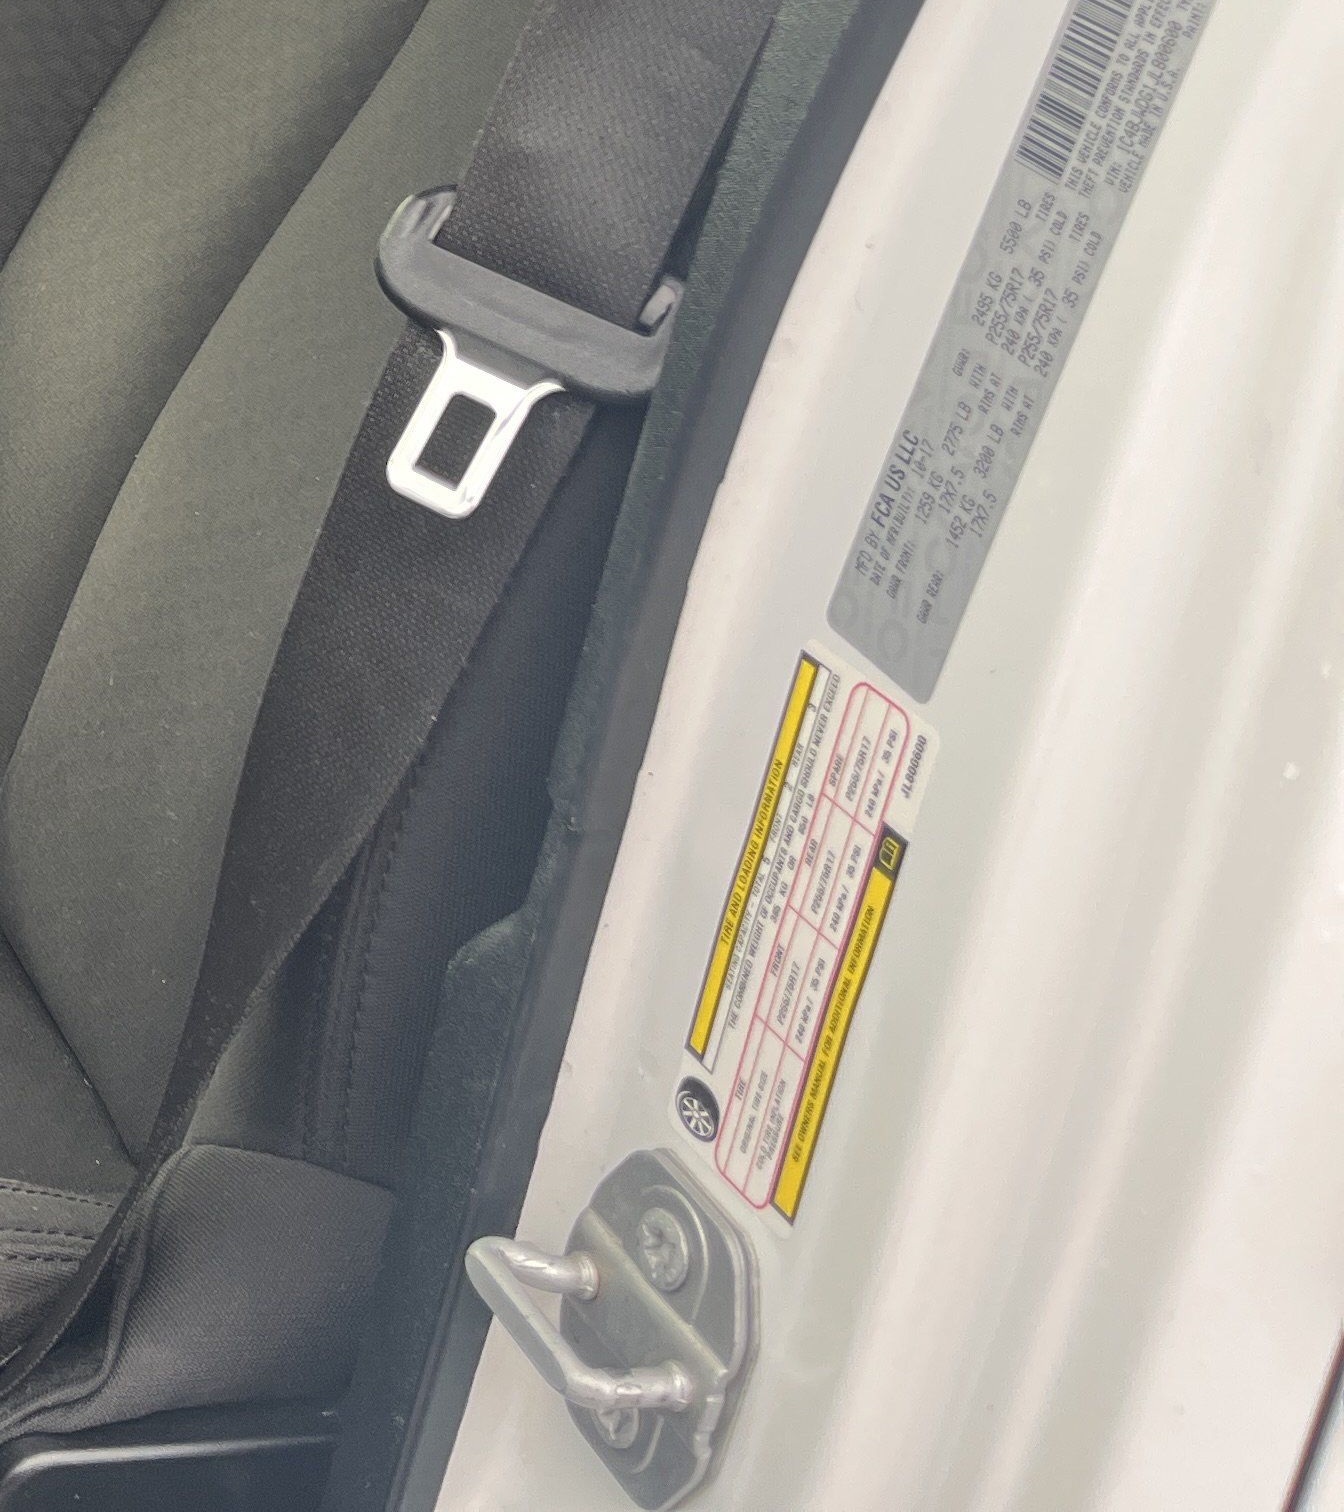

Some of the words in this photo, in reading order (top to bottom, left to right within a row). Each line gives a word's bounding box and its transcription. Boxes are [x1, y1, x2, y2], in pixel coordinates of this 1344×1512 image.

[1114, 50, 1131, 68] TO
[1121, 28, 1141, 52] ALL
[1093, 68, 1124, 120] CONFORMS
[1077, 166, 1100, 200] THEFT
[1090, 103, 1127, 168] PREVENTION
[1116, 46, 1151, 105] STANDARDS
[1141, 29, 1158, 45] IN
[1074, 119, 1103, 165] VEHICLE
[1116, 148, 1145, 195] VEHICLE
[1135, 120, 1157, 149] MADE
[1148, 101, 1164, 118] IN
[1063, 163, 1085, 193] THIS
[1102, 159, 1124, 188] VIN:
[970, 291, 995, 327] 2495
[984, 268, 1003, 292] KG
[998, 218, 1024, 255] 5500
[1013, 196, 1033, 218] LB
[912, 488, 936, 525] 1259
[925, 467, 945, 492] KG
[939, 419, 964, 457] 2775
[953, 398, 973, 422] LB
[967, 360, 987, 390] WITH
[983, 264, 1027, 346] P255/75R17
[1034, 190, 1056, 223] TIRES
[936, 463, 966, 515] 17X7.5
[976, 386, 996, 415] RIMS
[987, 370, 1003, 388] AT
[999, 326, 1021, 356] 240
[1012, 303, 1030, 326] KPA
[1026, 265, 1046, 287] 35
[1048, 207, 1069, 238] COLD
[943, 513, 968, 550] 1452
[957, 491, 977, 516] KG
[971, 442, 997, 480] 3200
[985, 420, 1005, 445] LB
[999, 382, 1020, 413] WITH
[1016, 285, 1060, 368] P255/75R17
[1068, 210, 1090, 243] TIRES
[967, 487, 998, 539] 17X7.5
[1008, 409, 1029, 438] RIMS
[1019, 392, 1035, 410] AT
[1032, 347, 1055, 378] 240
[1045, 324, 1063, 348] KPA
[1059, 286, 1080, 310] 35
[1081, 228, 1103, 258] COLD
[893, 426, 920, 466] LLC
[882, 461, 906, 494] US
[868, 488, 896, 530] FCA
[868, 560, 886, 587] DATE
[878, 545, 891, 562] OF
[910, 437, 936, 480] 10-17
[863, 527, 881, 550] BY
[853, 547, 873, 577] MFD
[822, 670, 842, 715] EXCEED
[812, 711, 829, 749] NEVER
[885, 725, 899, 750] PSI
[799, 745, 818, 790] SHOULD
[827, 749, 845, 789] SPARE
[880, 746, 892, 766] 35
[788, 785, 806, 825] CARGO
[719, 916, 735, 946] TIRE
[727, 888, 743, 919] AND
[735, 836, 759, 893] LOADING
[751, 755, 784, 840] INFORMATION
[781, 822, 795, 847] AND
[803, 835, 819, 868] REAR
[849, 841, 862, 865] PSI
[763, 844, 788, 906] OCCUPANTS
[777, 878, 789, 898] KG
[785, 852, 797, 872] OR
[844, 860, 857, 881] 35
[759, 903, 770, 921] OF
[828, 909, 842, 934] 240
[747, 919, 766, 959] WEIGHT
[845, 901, 875, 976] INFORMATION
[768, 940, 786, 978] FRONT
[813, 954, 827, 978] PSI
[732, 957, 755, 1011] COMBINED
[808, 973, 821, 993] 35
[727, 1009, 739, 1031] THE
[827, 974, 851, 1035] ADDITIONAL
[793, 1021, 807, 1044] 240
[820, 1033, 834, 1057] FOR
[733, 1075, 747, 1102] TIRE
[808, 1056, 828, 1100] MANUAL
[796, 1098, 815, 1142] OWNERS
[790, 1141, 803, 1163] SEE
